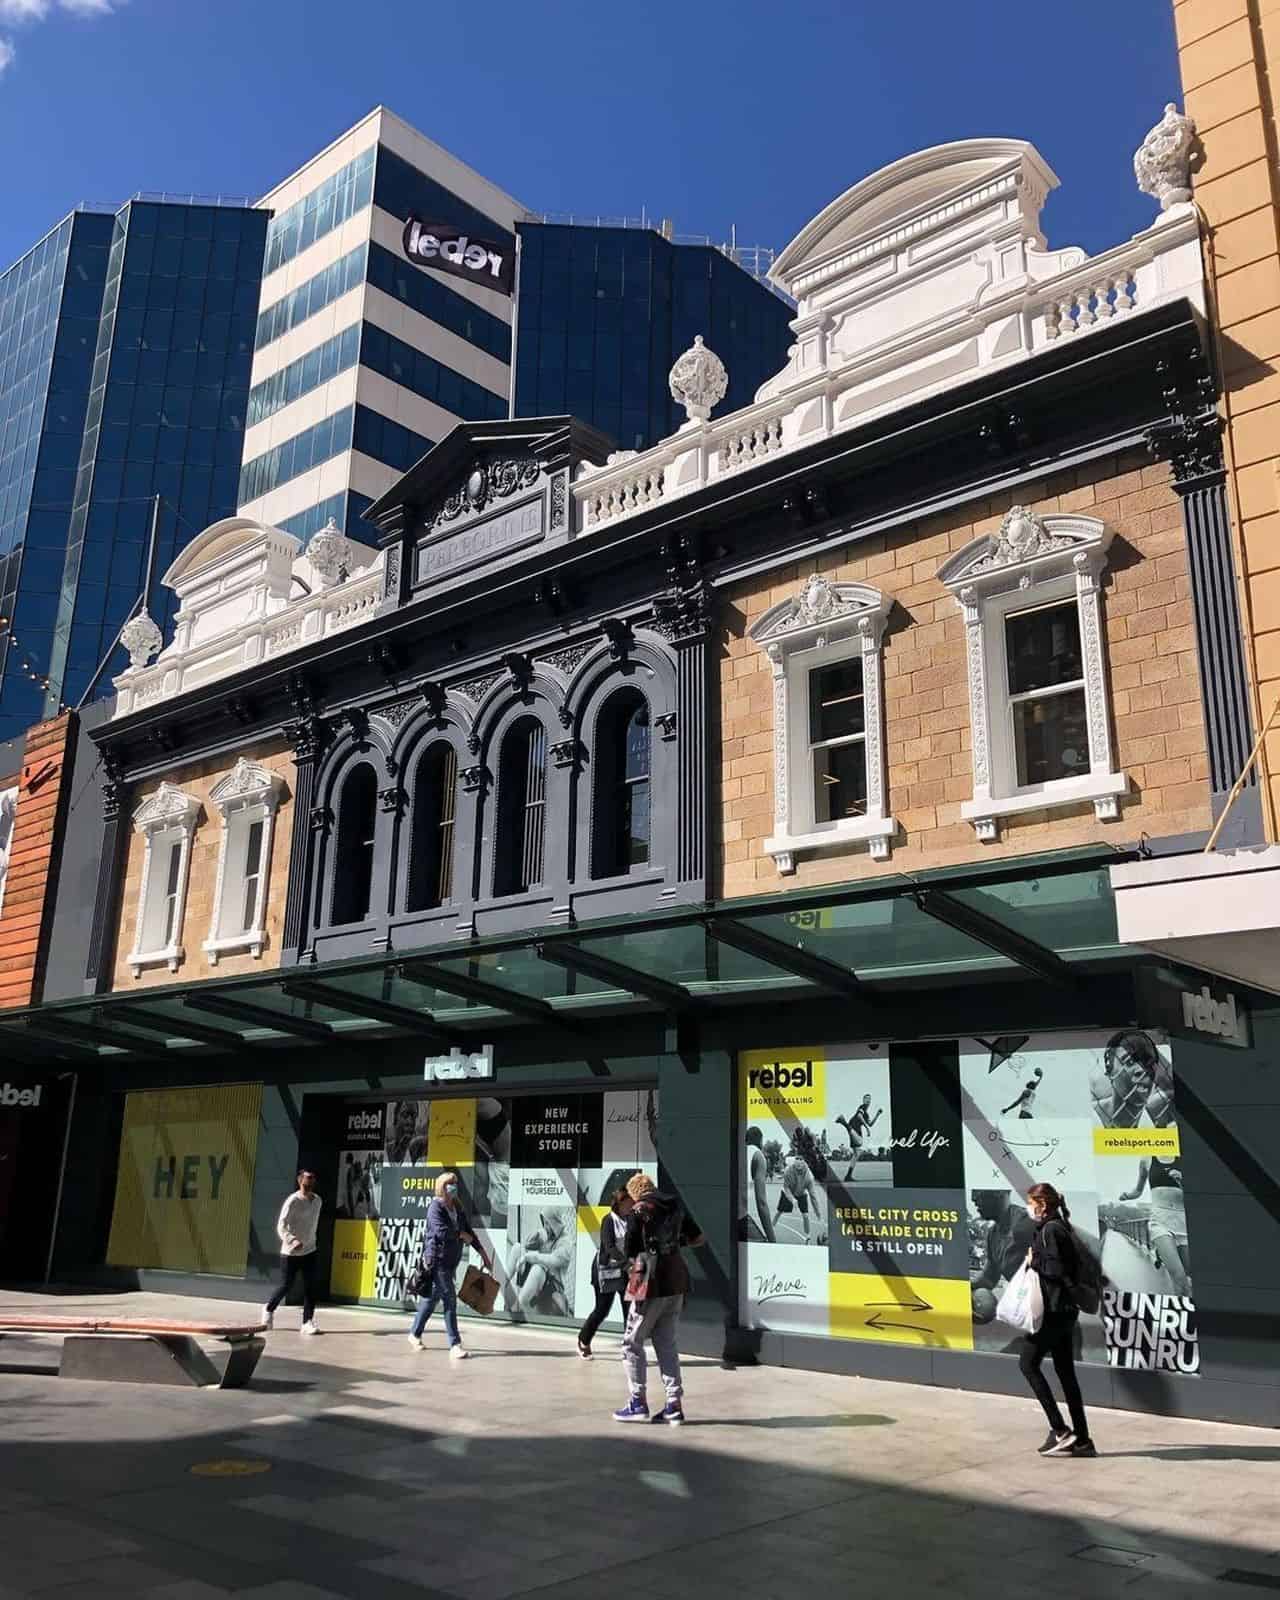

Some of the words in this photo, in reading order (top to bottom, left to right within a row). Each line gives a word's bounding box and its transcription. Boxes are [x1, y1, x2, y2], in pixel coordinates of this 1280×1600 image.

[1181, 986, 1237, 1038] rebel
[424, 1044, 494, 1081] rebel
[748, 1060, 813, 1089] rebel
[0, 1083, 42, 1106] bel
[750, 1096, 771, 1105] SPORT
[783, 1096, 814, 1105] CALLING
[348, 1109, 382, 1129] rebel
[545, 1107, 569, 1119] NEW
[525, 1122, 589, 1135] EXPERIENCE
[538, 1139, 573, 1151] STORE
[1104, 1138, 1175, 1149] rebelsport.com
[153, 1154, 230, 1200] HEY
[402, 1178, 436, 1191] OPENI
[835, 1207, 875, 1219] REBEL
[878, 1208, 909, 1221] CITY
[913, 1210, 959, 1222] CROSS
[379, 1226, 417, 1252] RUN
[841, 1223, 912, 1237] (ADELAIDE
[915, 1226, 953, 1240] CITY)
[851, 1240, 863, 1252] IS
[866, 1240, 903, 1254] STILL
[906, 1243, 944, 1256] OPEN
[376, 1251, 414, 1279] RUN
